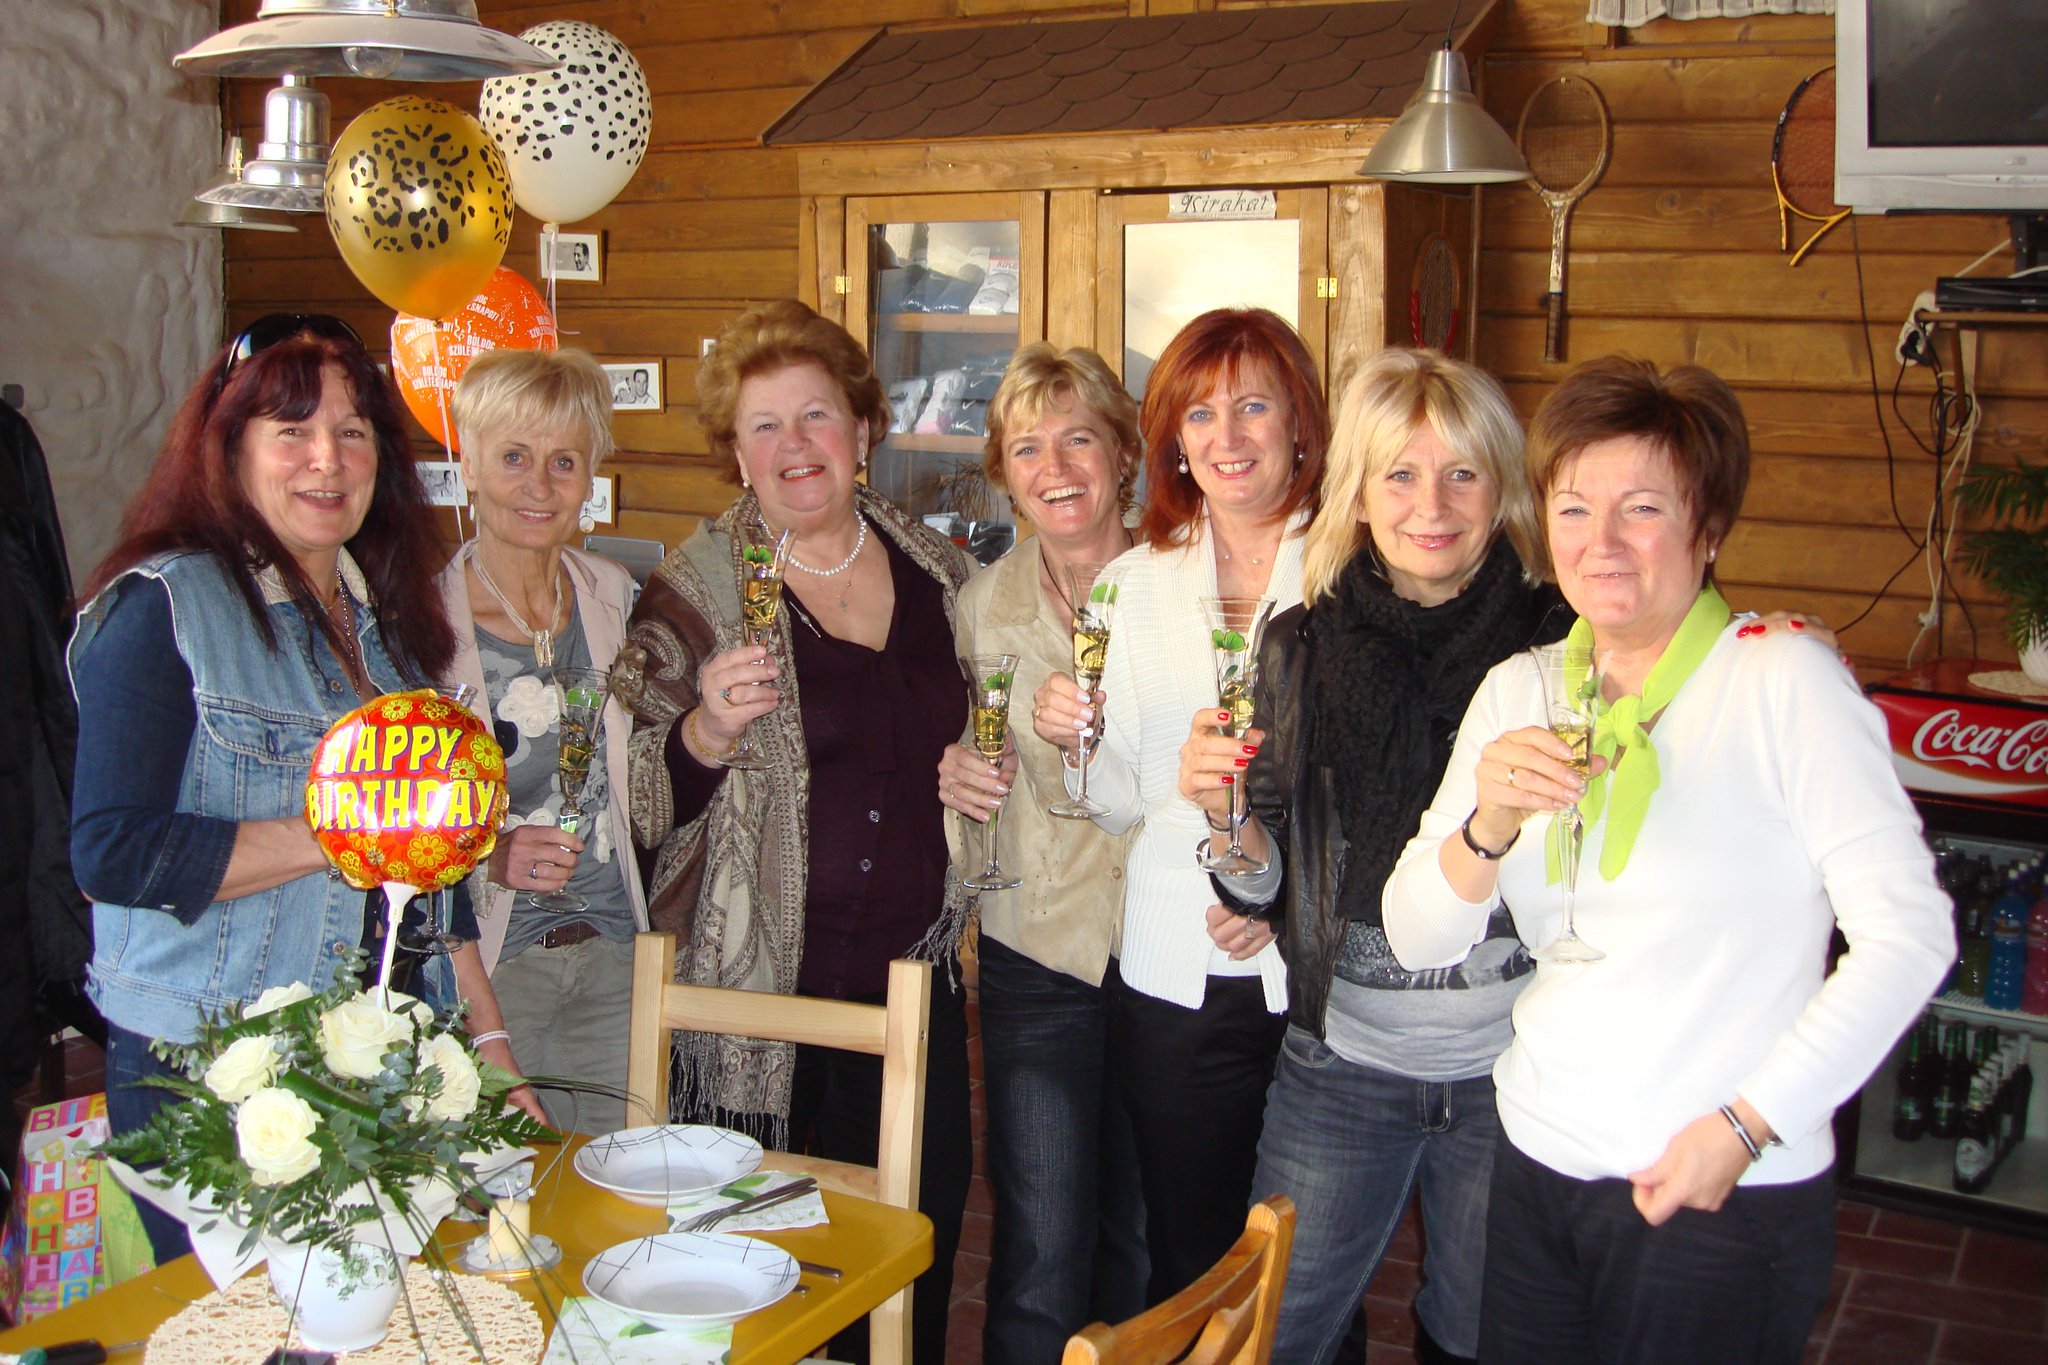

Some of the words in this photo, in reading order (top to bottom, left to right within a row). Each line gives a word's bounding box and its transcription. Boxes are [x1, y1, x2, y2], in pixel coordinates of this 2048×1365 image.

[1181, 190, 1269, 213] Kirakat
[324, 725, 463, 774] HAPPY
[1912, 709, 2048, 776] Coca-Co
[307, 779, 499, 832] BIRTHDAY
